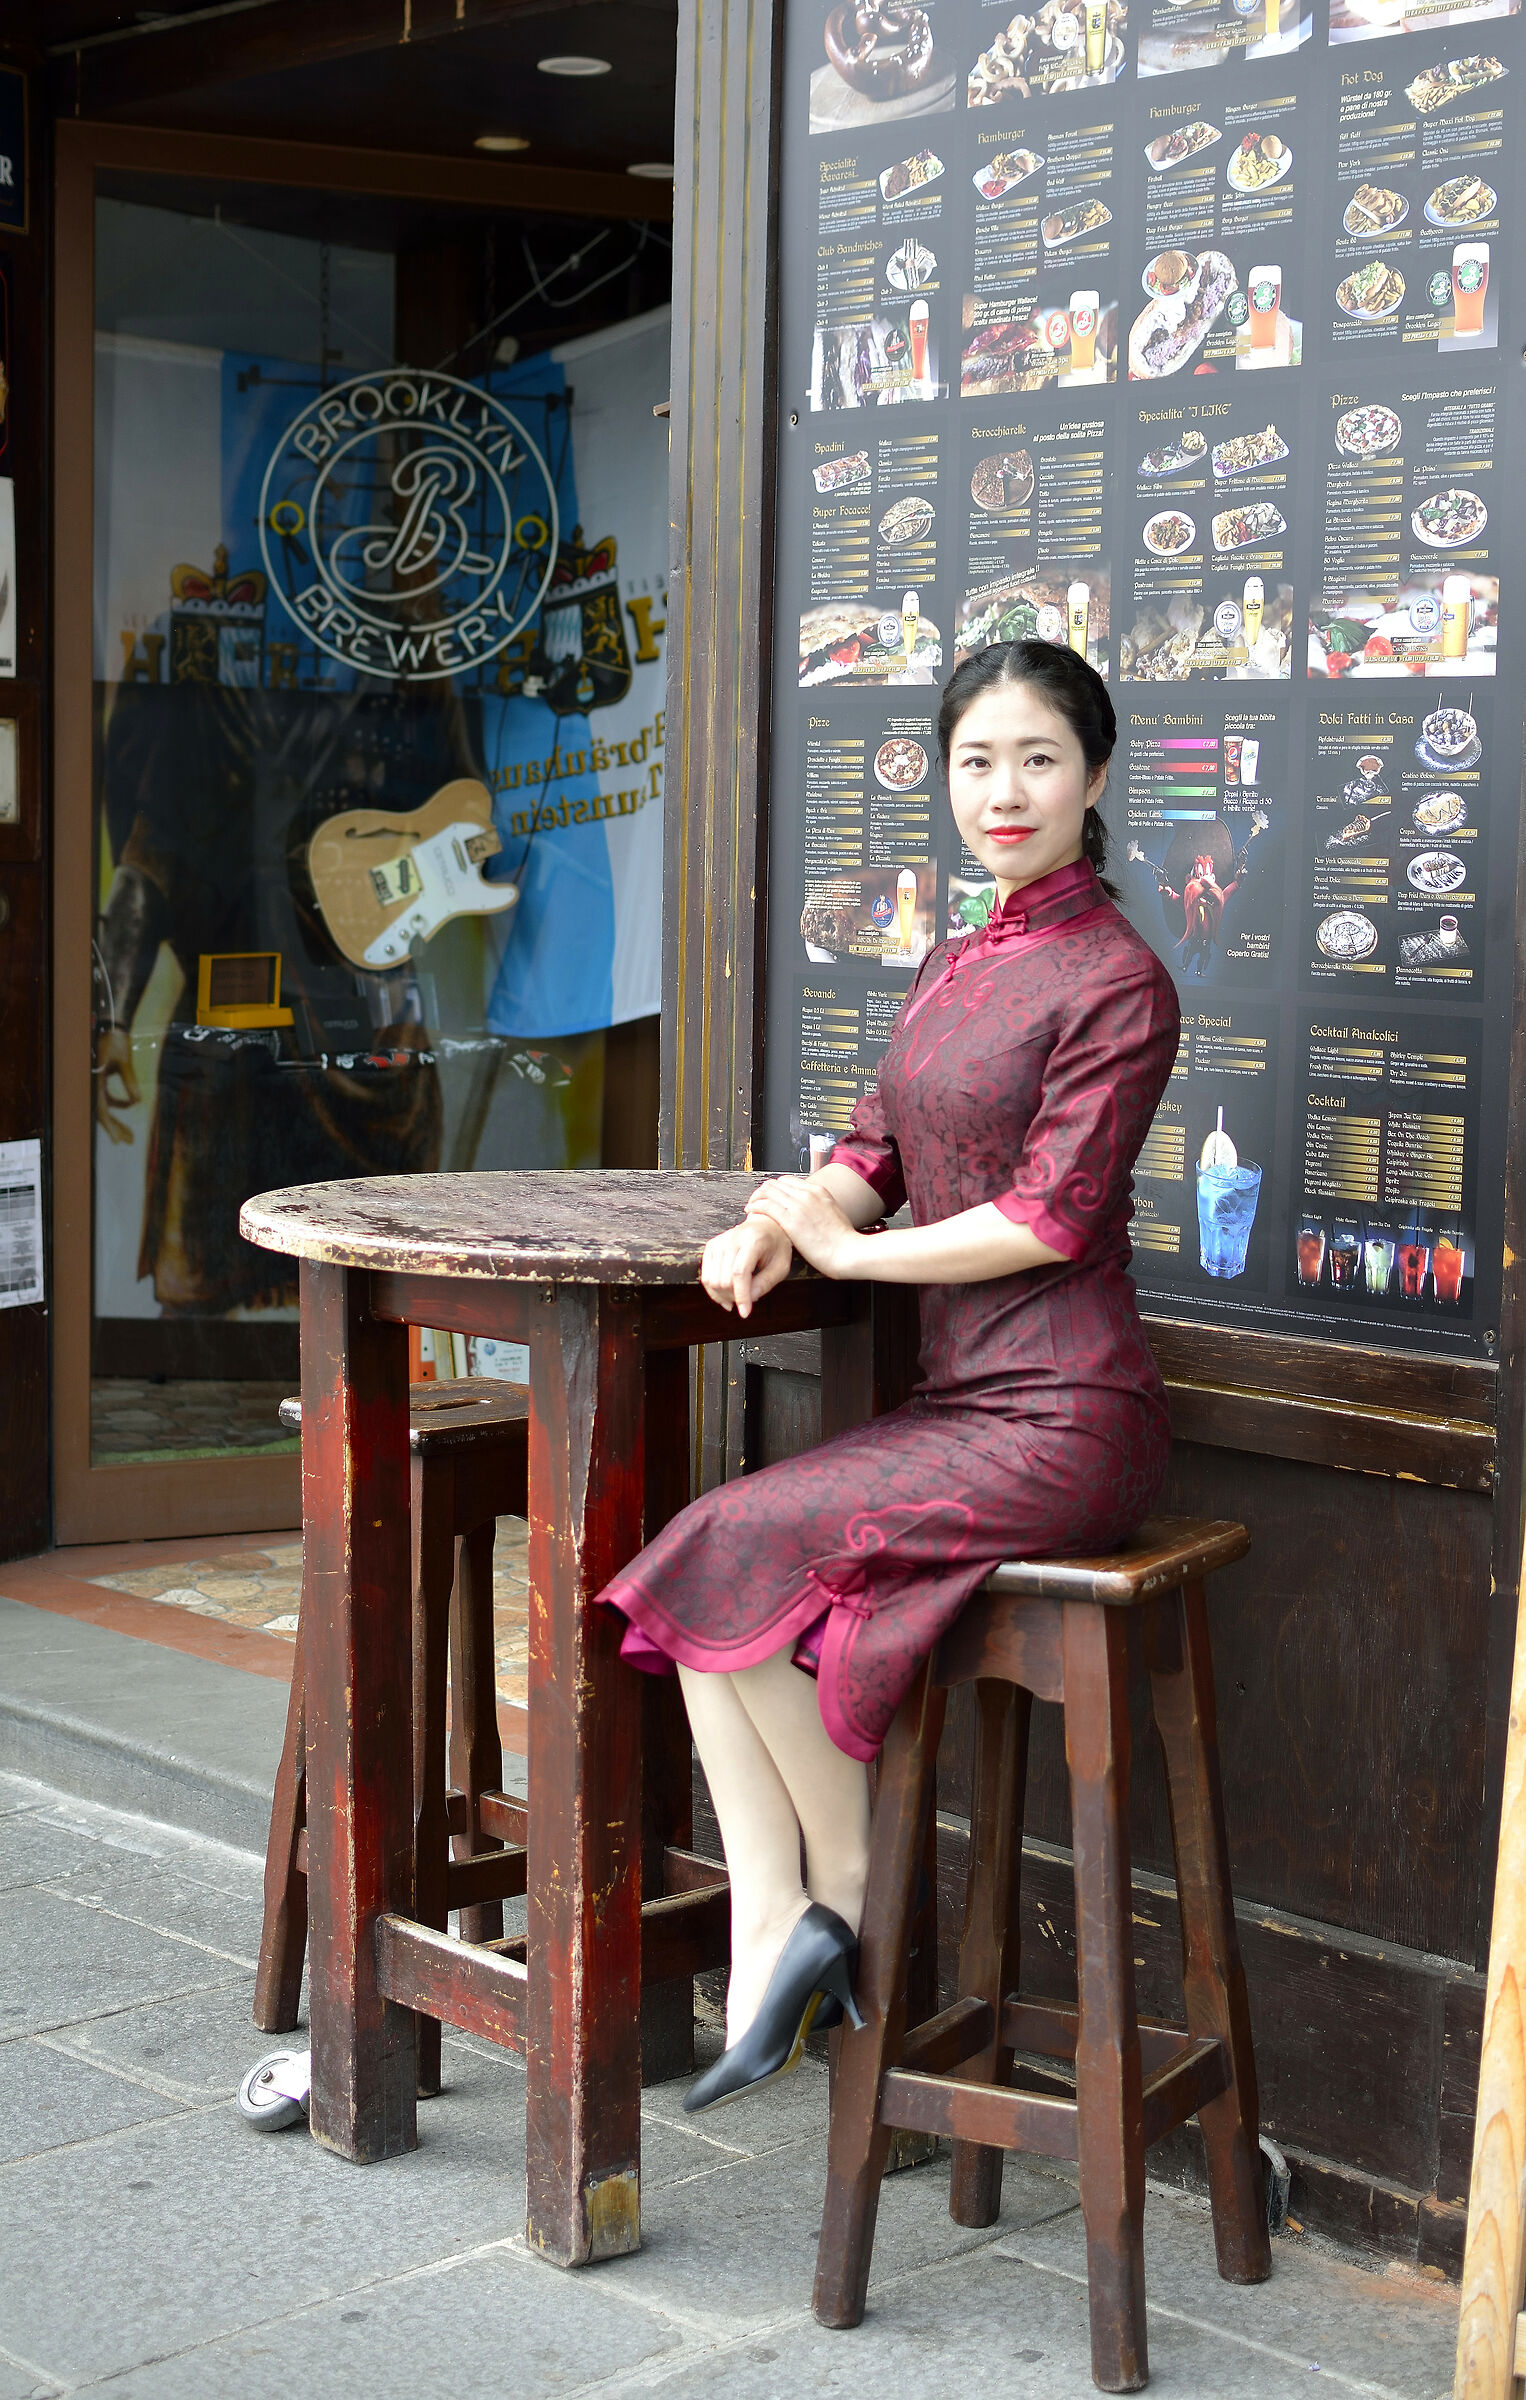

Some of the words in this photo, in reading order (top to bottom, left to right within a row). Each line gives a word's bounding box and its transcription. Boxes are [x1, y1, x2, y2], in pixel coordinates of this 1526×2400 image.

[1341, 73, 1359, 86] Hot
[1363, 70, 1384, 83] Dog
[1341, 93, 1363, 104] Würstel
[1373, 91, 1384, 99] 180
[1368, 100, 1388, 108] nostra
[1150, 104, 1201, 119] Hamburger
[1339, 109, 1376, 123] produzione!
[977, 129, 1025, 145] Hamburger
[817, 246, 835, 257] Club
[837, 240, 883, 255] Sandwiches
[973, 302, 988, 311] Super
[989, 299, 1017, 308] Hamburger
[1329, 393, 1359, 408] Pizze
[1401, 393, 1421, 402] Scegli
[1422, 390, 1449, 401] l'impasto
[1449, 390, 1462, 398] che
[1463, 387, 1492, 398] preferisci
[1138, 407, 1186, 424] Specialita'
[294, 380, 527, 476] BROOKLYN
[971, 424, 1027, 439] Scrocchiarelle
[812, 506, 836, 519] Super
[839, 504, 871, 515] Focacce!
[295, 584, 515, 669] BREWERY
[808, 716, 830, 730] Pizze
[1130, 714, 1160, 726] Menu'
[1162, 713, 1204, 726] Bambini
[1224, 713, 1242, 722] Scegli
[1259, 713, 1276, 721] bibita
[1319, 713, 1343, 725] Dolci
[1347, 713, 1371, 725] Fatti
[1375, 713, 1384, 725] in
[1388, 712, 1414, 725] Casa
[1240, 933, 1250, 941] Per
[1246, 942, 1270, 950] bambini
[1227, 949, 1250, 958] Coperto
[1251, 950, 1269, 959] Gratis!
[802, 987, 837, 1000] Bevande
[1180, 1015, 1195, 1024] ace
[1198, 1014, 1232, 1028] Special
[1310, 1024, 1349, 1039] Cocktail
[1351, 1027, 1399, 1042] Analcolici
[800, 1060, 841, 1073] Caffetteria
[1307, 1093, 1346, 1108] Cocktail
